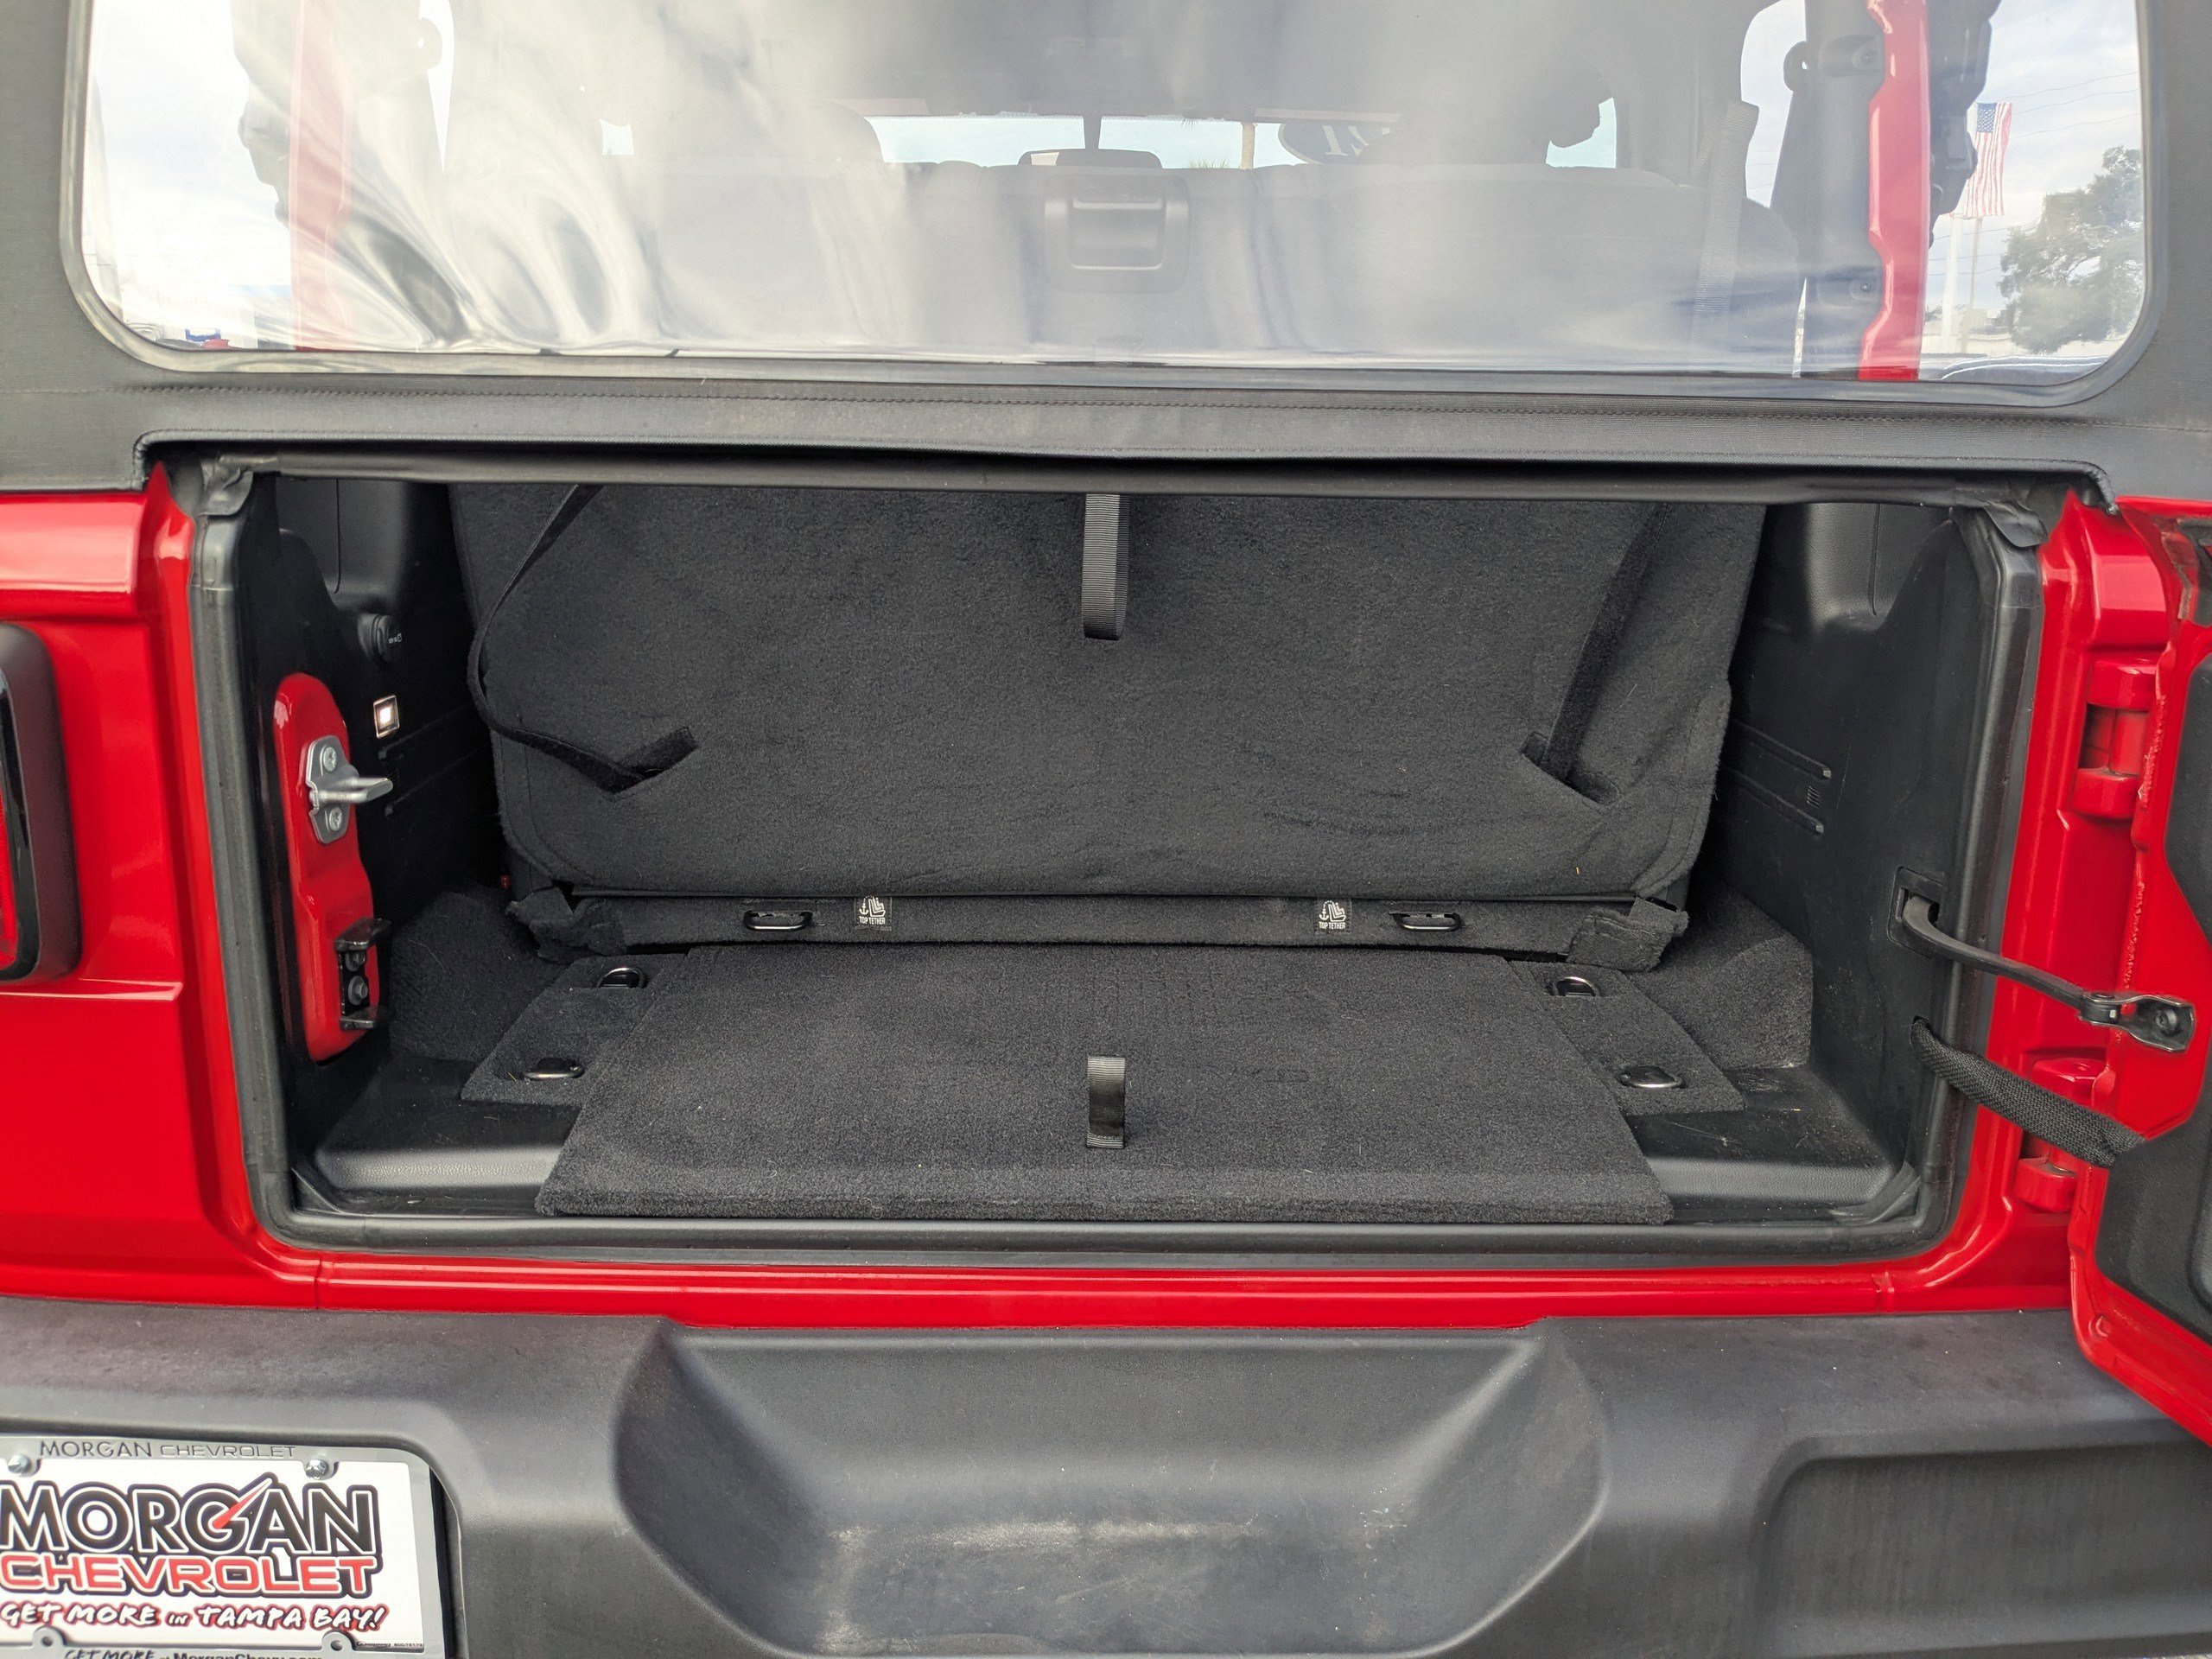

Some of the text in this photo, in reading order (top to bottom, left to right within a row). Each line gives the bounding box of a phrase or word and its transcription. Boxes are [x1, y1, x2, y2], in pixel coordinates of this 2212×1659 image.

[40, 1440, 296, 1459] MORGAN CHEVROLET
[0, 1474, 380, 1554] MORGAN
[0, 1555, 378, 1595] CHEVROLET
[0, 1602, 63, 1627] GET
[66, 1603, 159, 1627] MORE
[196, 1605, 304, 1629] TAMPA
[311, 1605, 388, 1630] BAY!
